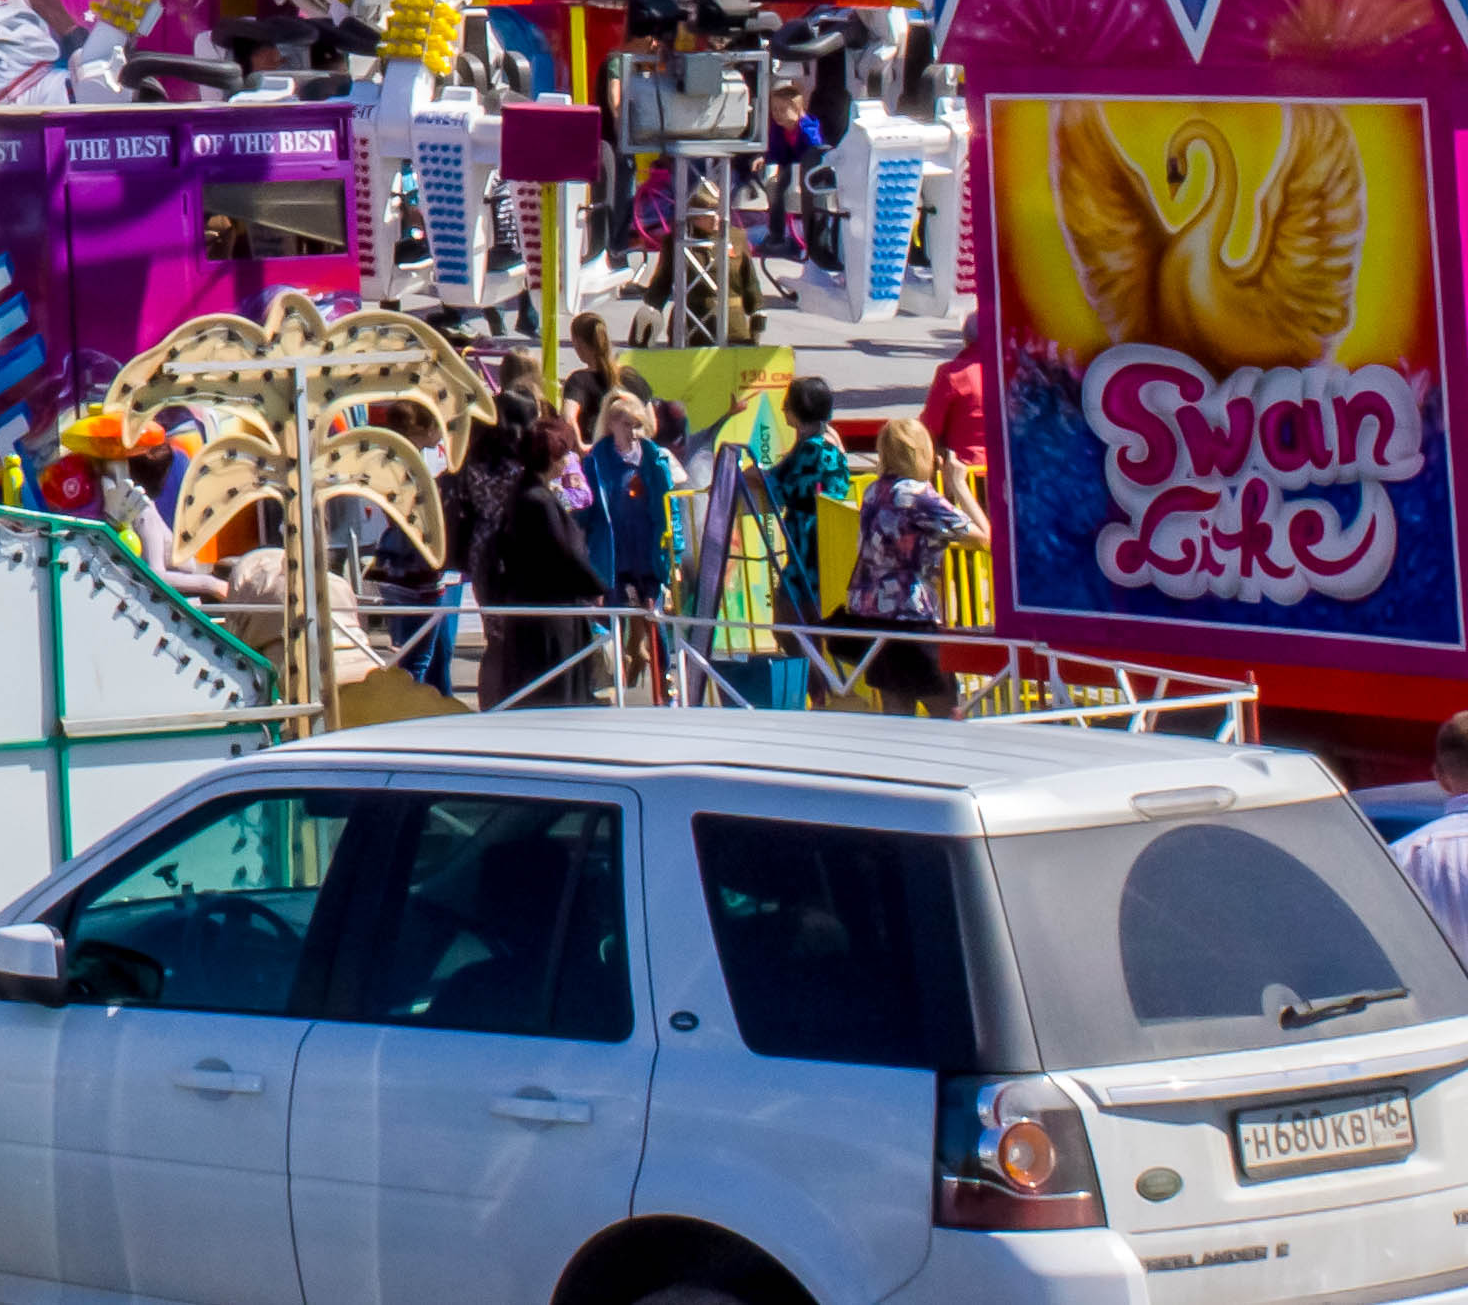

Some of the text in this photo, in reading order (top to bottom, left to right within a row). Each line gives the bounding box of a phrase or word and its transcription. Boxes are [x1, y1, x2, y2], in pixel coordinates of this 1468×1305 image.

[68, 134, 172, 162] THE BEST
[193, 127, 337, 157] OF THE BEST
[1101, 362, 1396, 487] Swan
[1114, 477, 1378, 581] Like
[1252, 1098, 1400, 1160] Н680КВ 46
